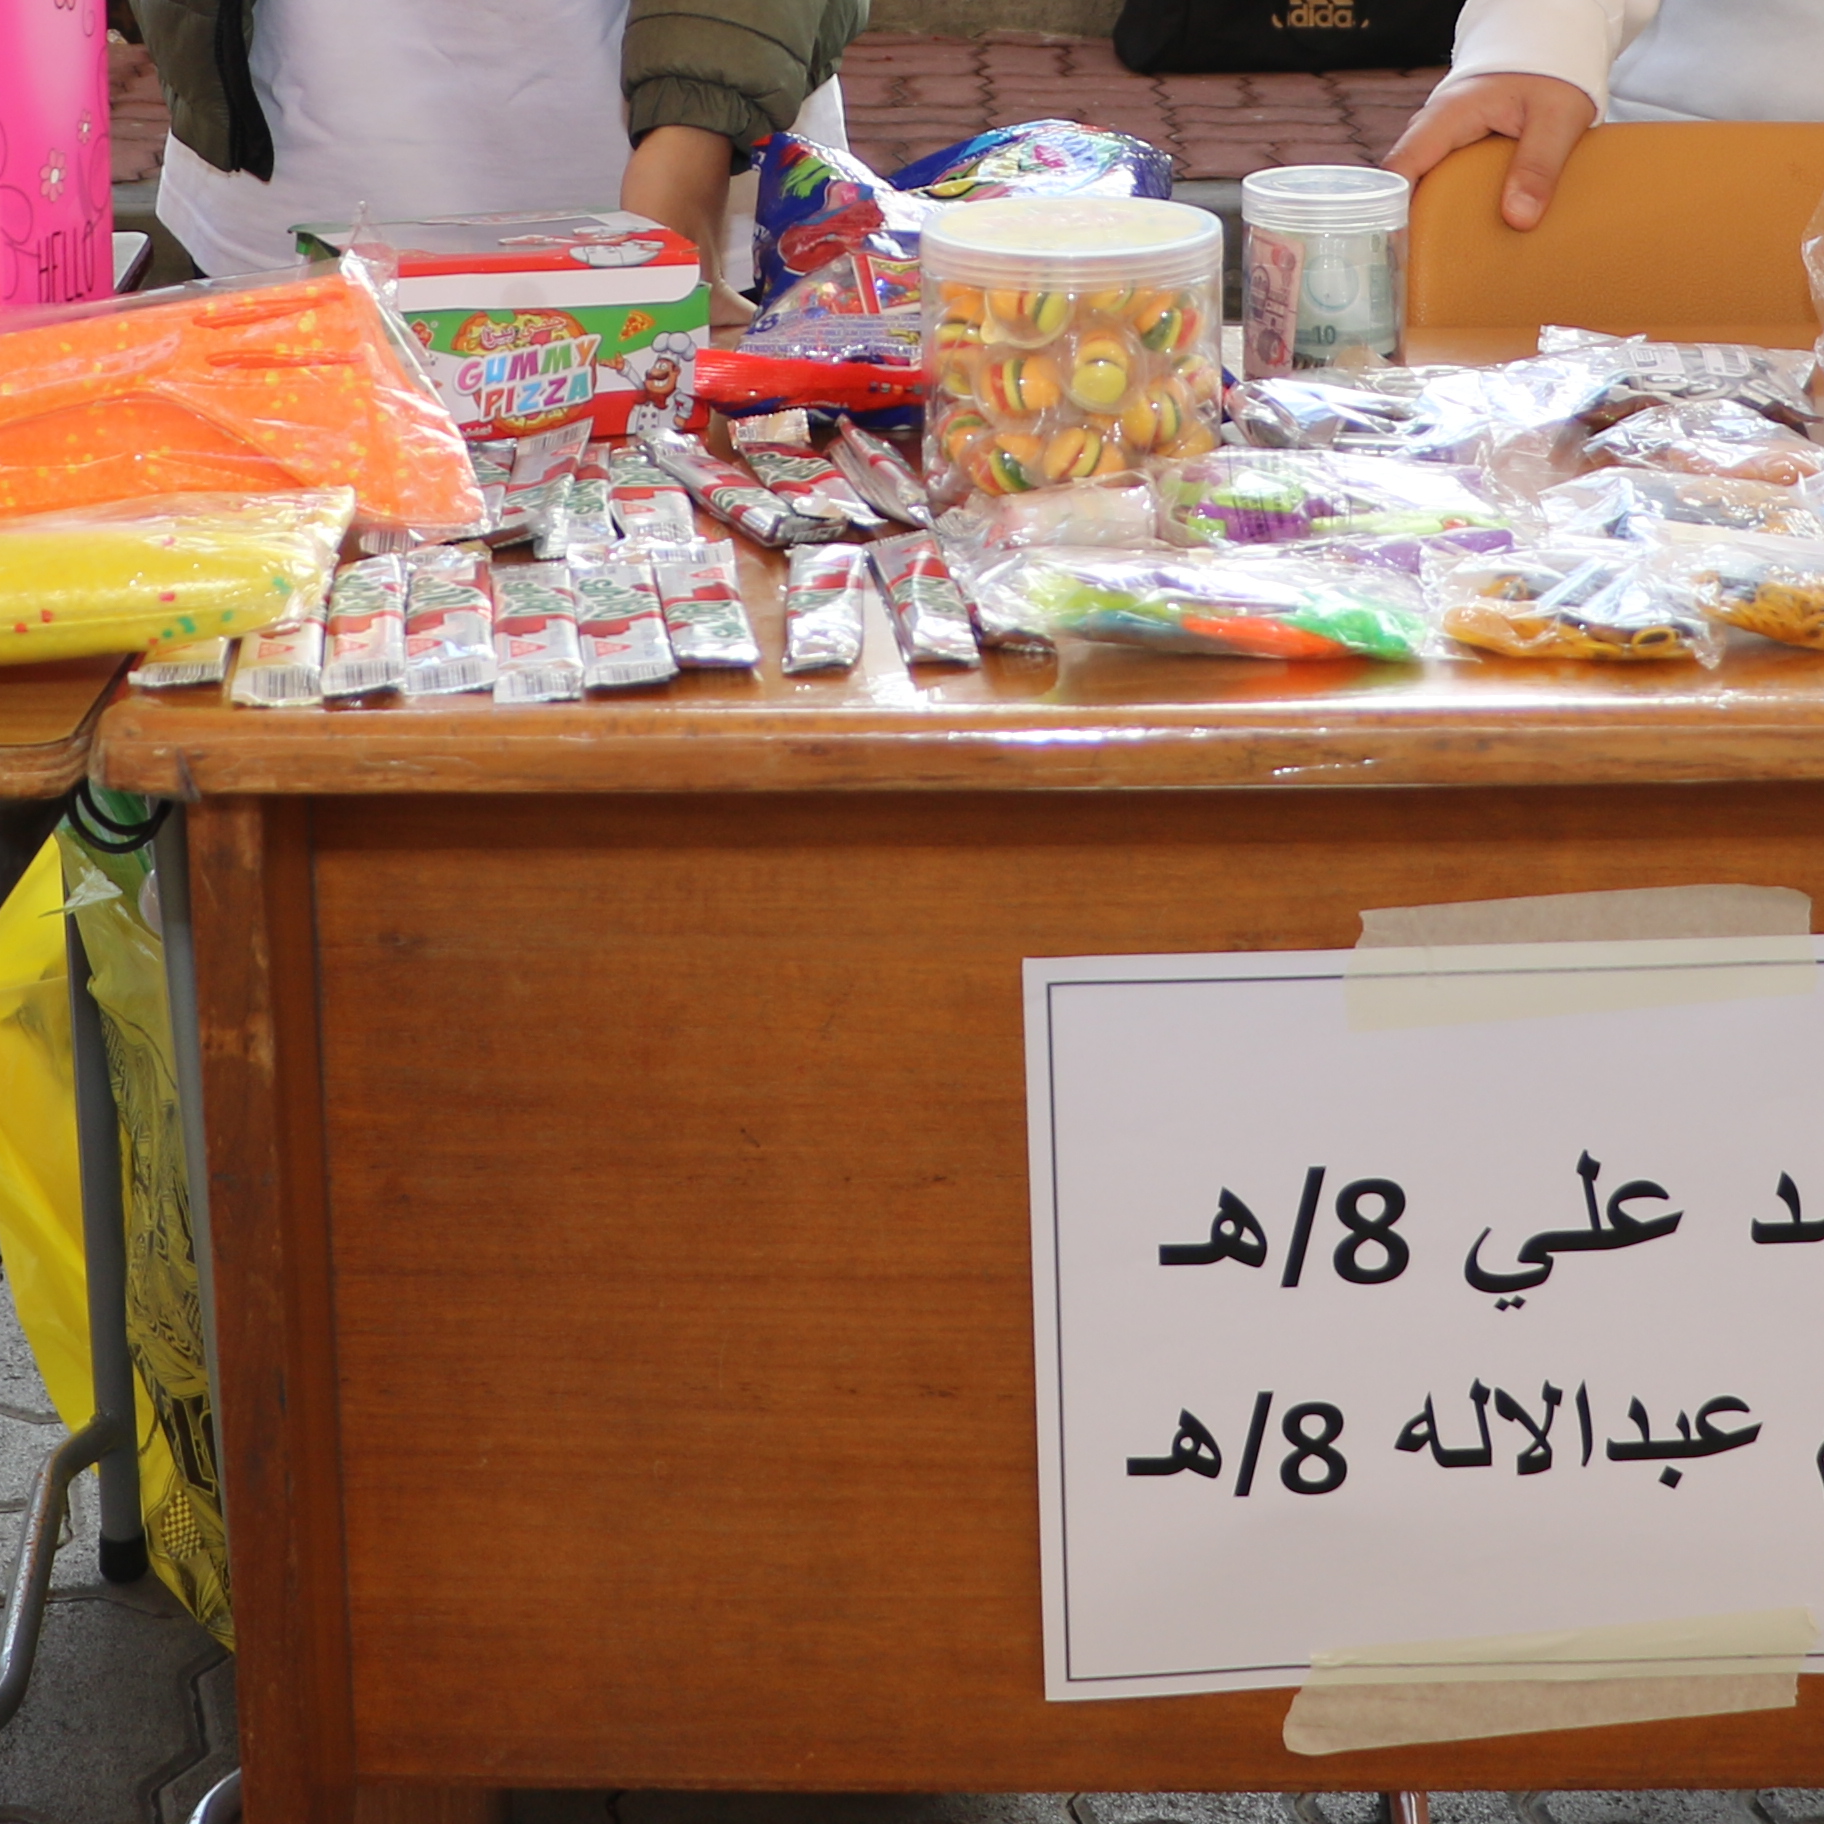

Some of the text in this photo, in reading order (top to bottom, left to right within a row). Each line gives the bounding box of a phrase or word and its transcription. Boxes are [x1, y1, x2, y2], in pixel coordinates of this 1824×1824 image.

[456, 337, 600, 392] GUMMY
[482, 369, 590, 418] PIZZA
[1463, 1149, 1684, 1313] علي
[1393, 1378, 1763, 1490] عبدالاله
